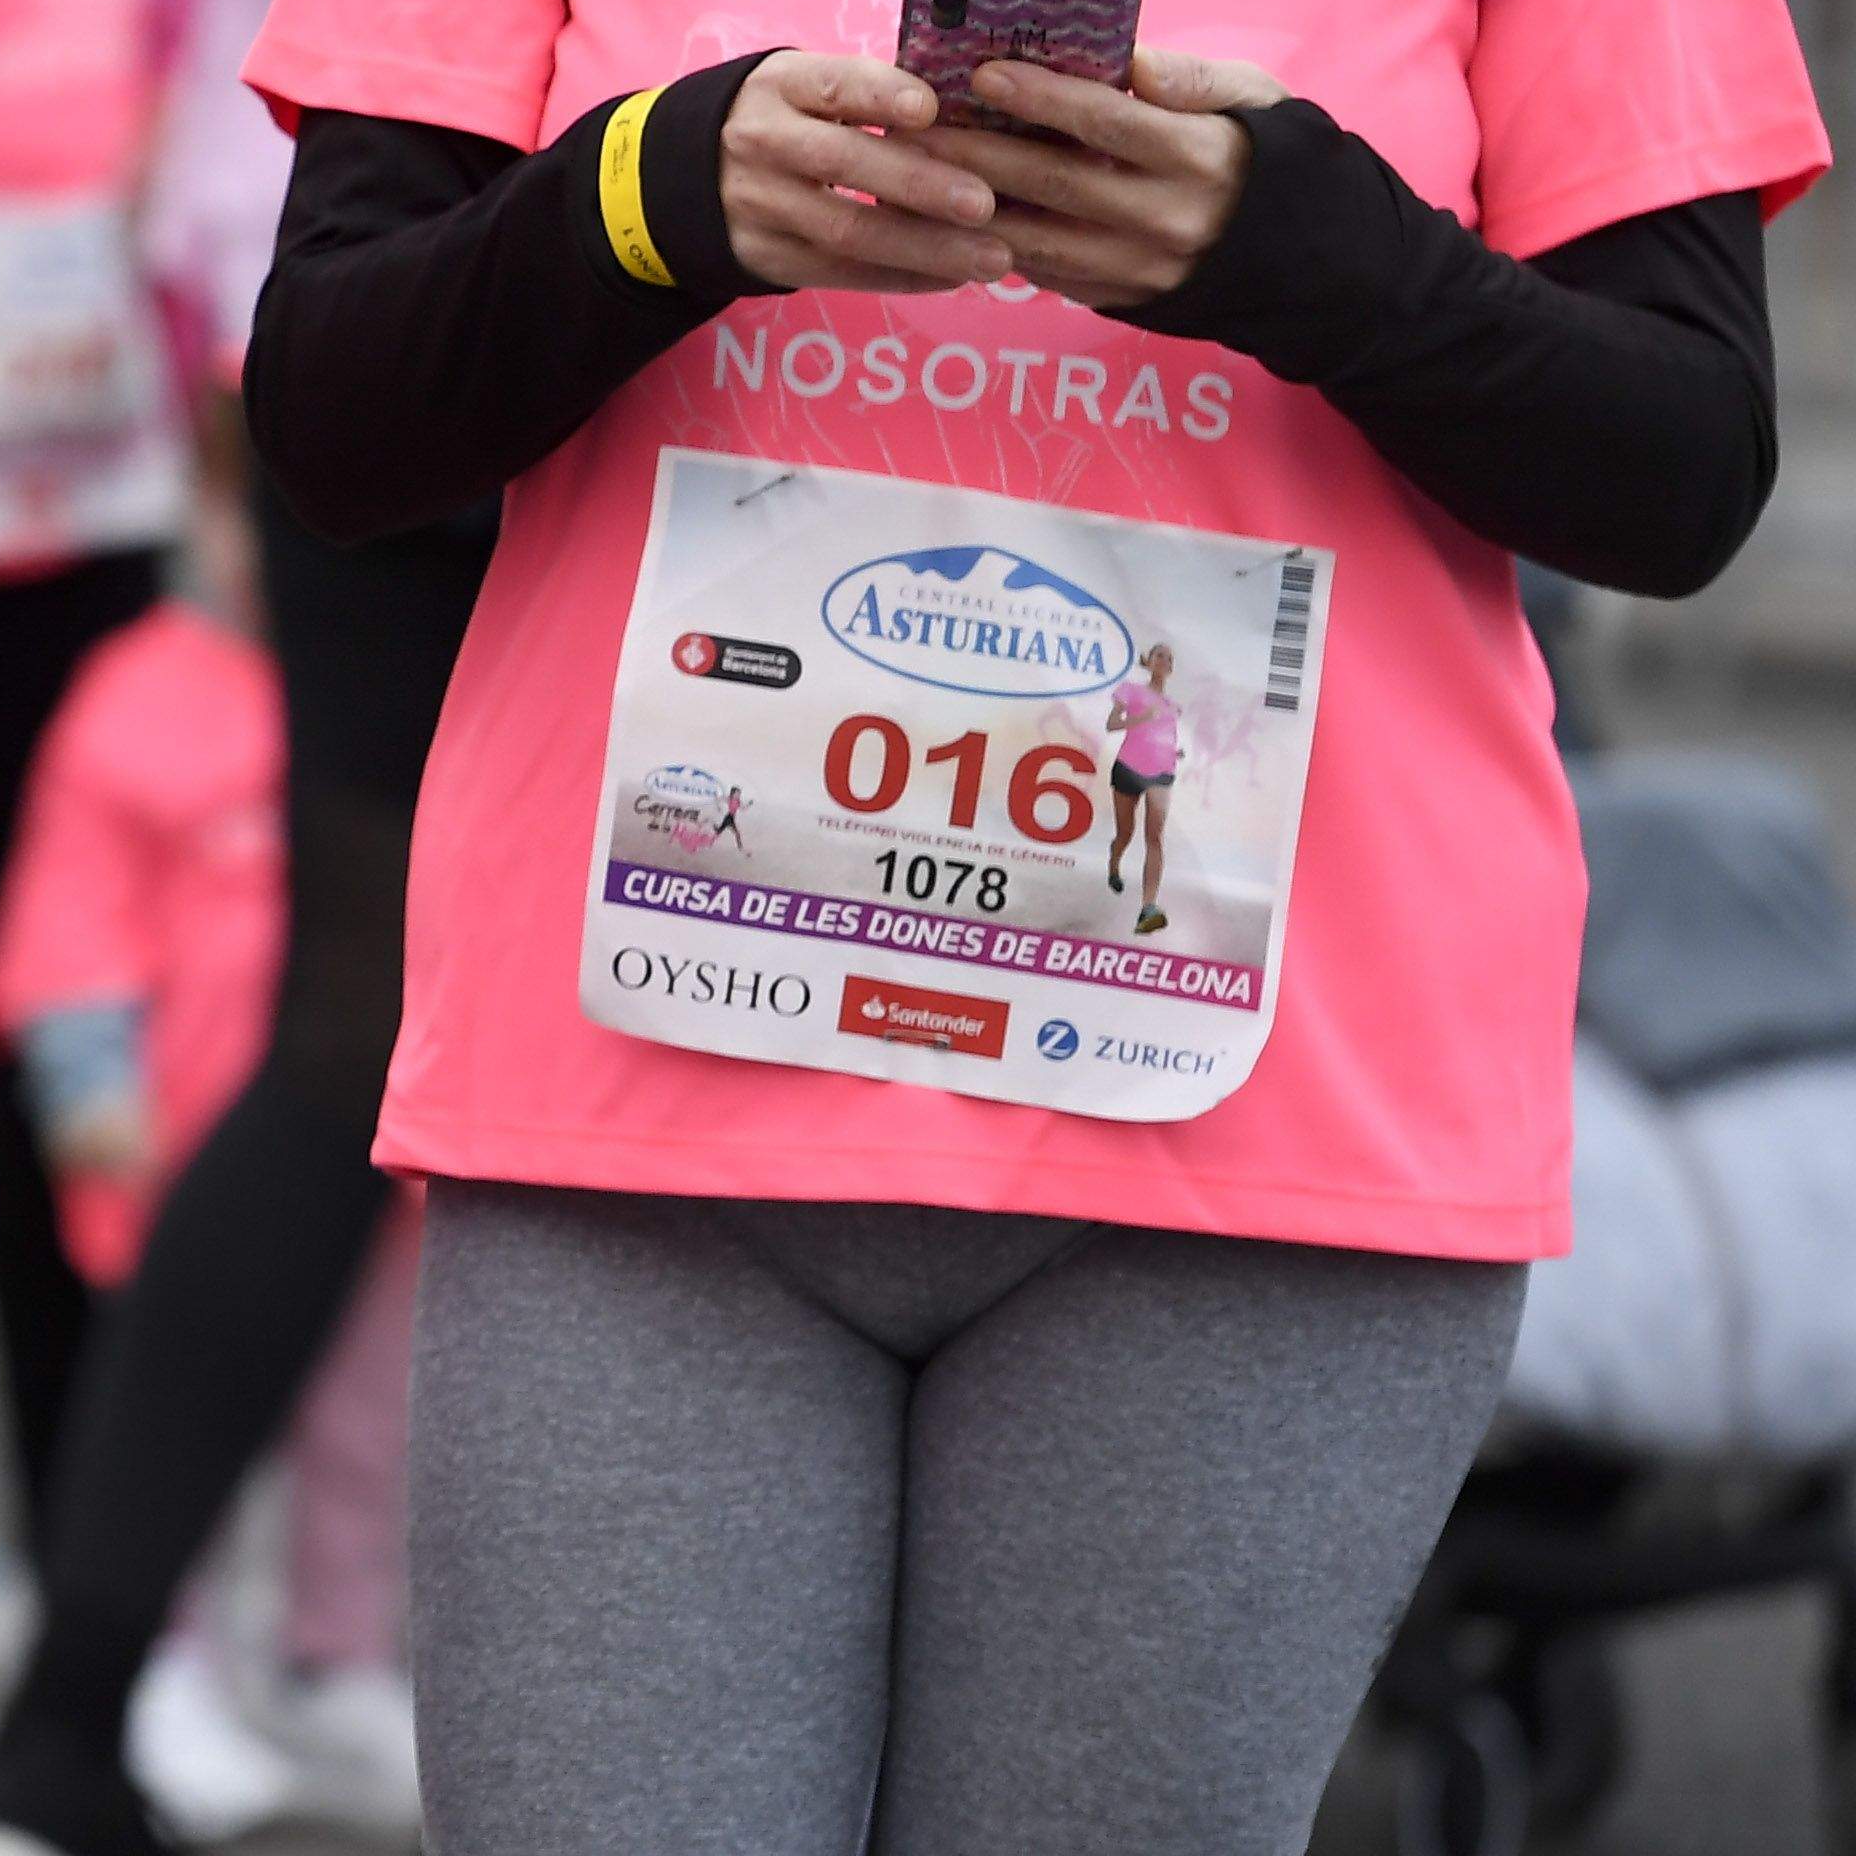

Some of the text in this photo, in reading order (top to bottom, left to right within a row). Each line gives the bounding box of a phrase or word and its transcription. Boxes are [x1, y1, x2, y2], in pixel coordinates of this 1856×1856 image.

[713, 324, 1233, 442] NOSOTRAS
[843, 583, 1105, 676] ASTURIANA
[823, 713, 1098, 844] 016
[873, 847, 1008, 913] 1078
[622, 869, 1252, 1004] CURSA DE LES DONES DE BARCELONA
[612, 946, 812, 1019] OYSHO
[888, 1000, 987, 1038] Santander
[1094, 1034, 1215, 1075] ZURICH
